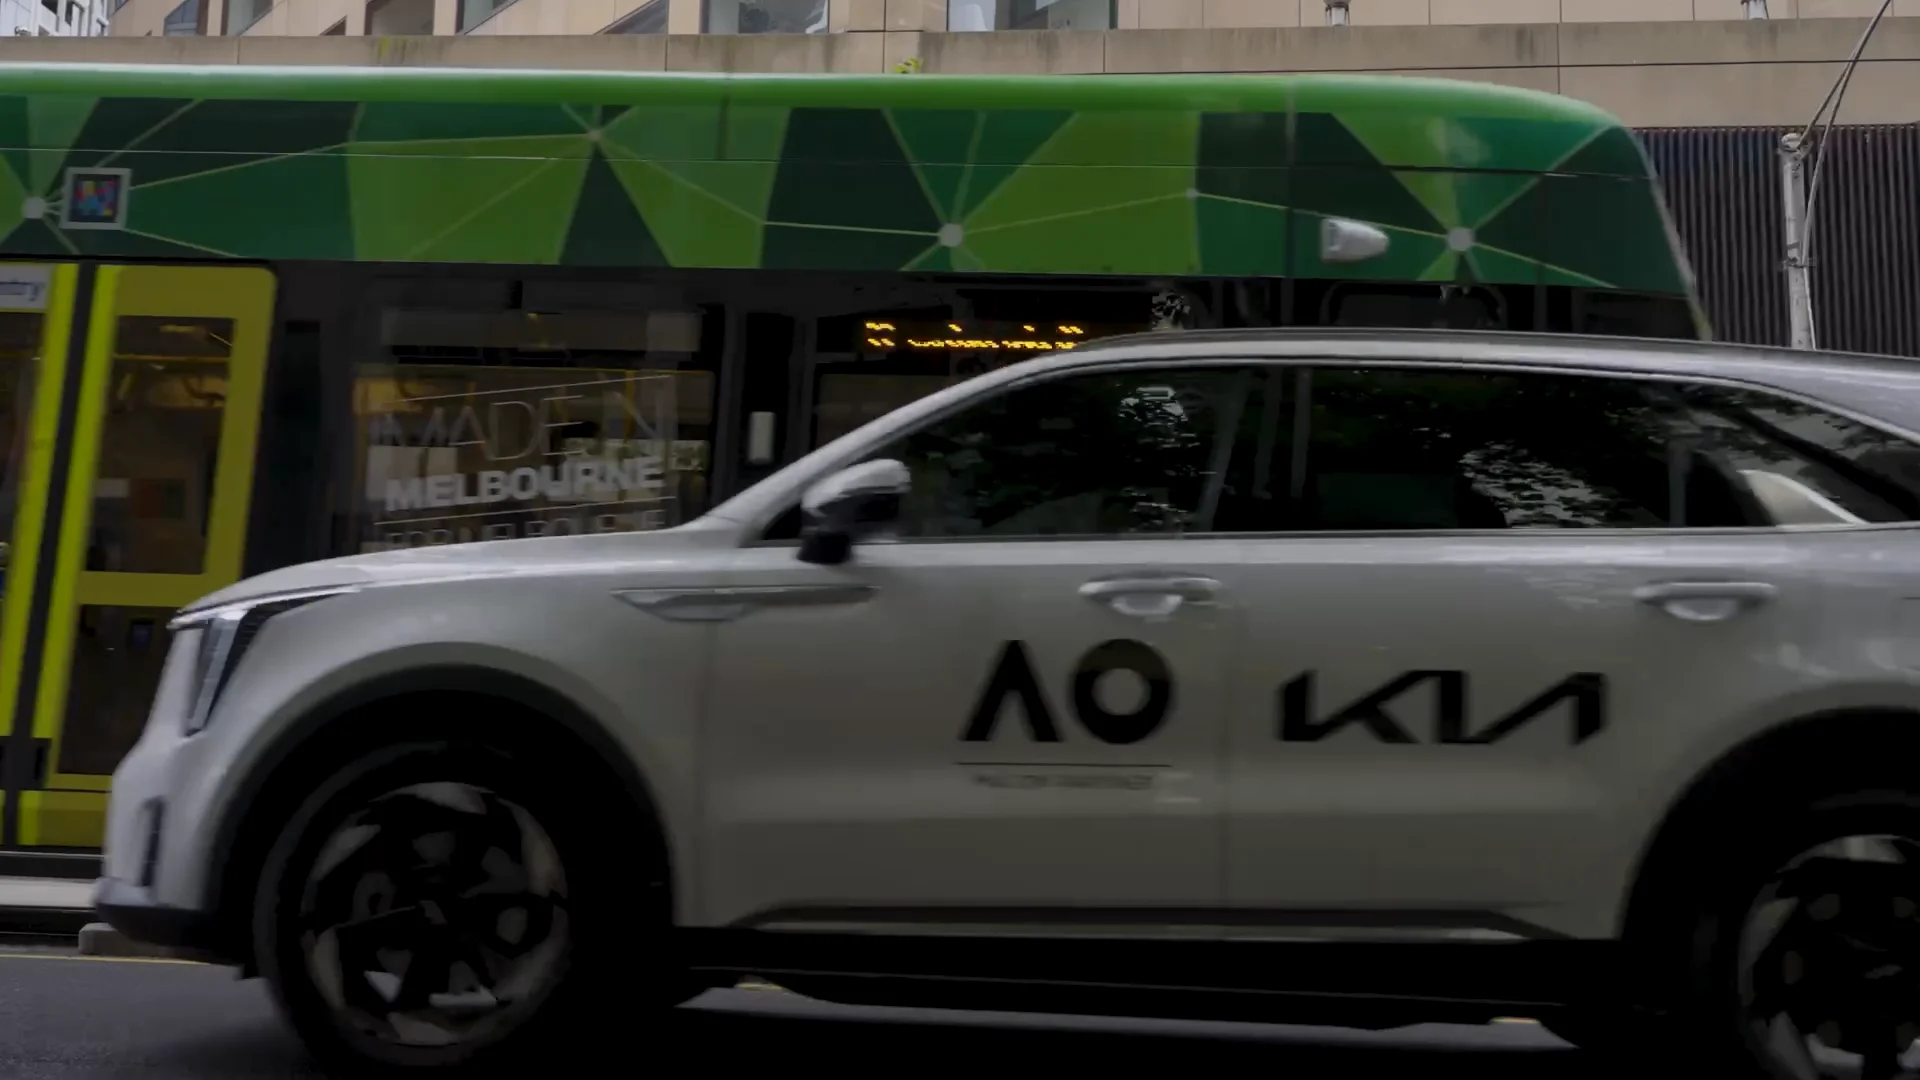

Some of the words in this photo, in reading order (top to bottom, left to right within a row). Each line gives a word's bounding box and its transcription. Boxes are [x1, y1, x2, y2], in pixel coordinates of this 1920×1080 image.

[372, 395, 584, 469] MADE
[386, 455, 665, 511] MELBOURNE
[958, 639, 1172, 744] AO
[1280, 670, 1606, 744] KIA
